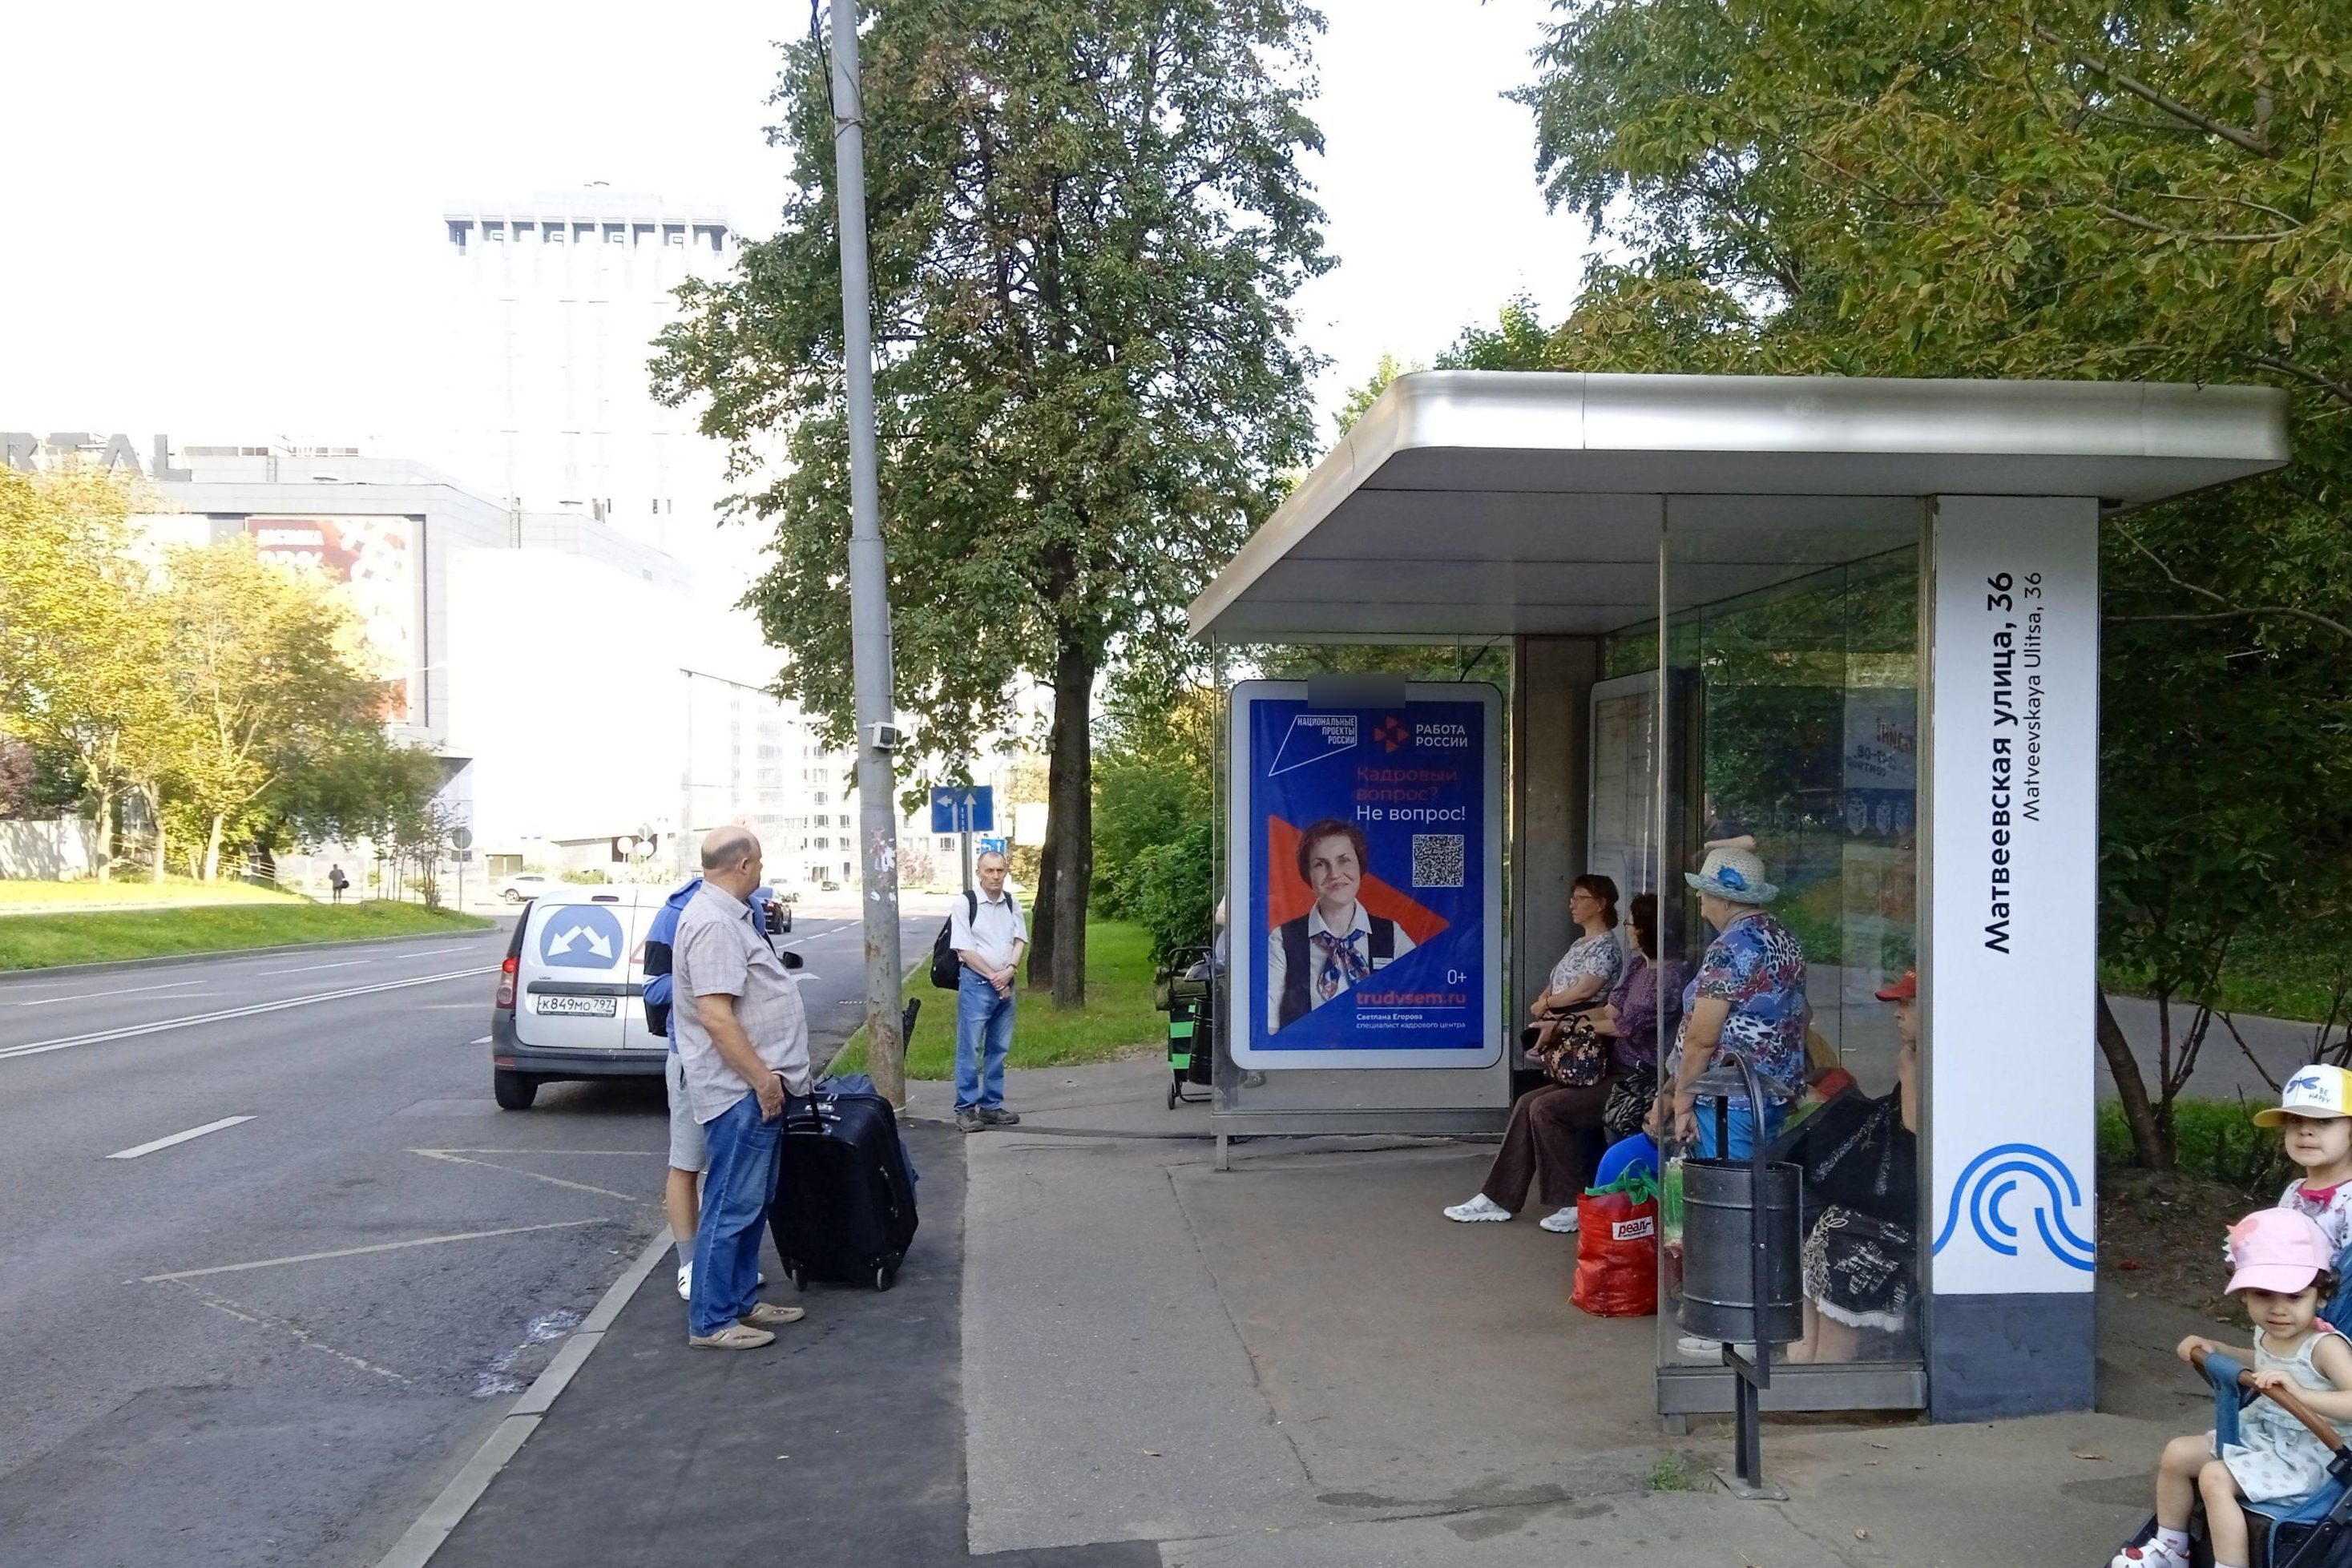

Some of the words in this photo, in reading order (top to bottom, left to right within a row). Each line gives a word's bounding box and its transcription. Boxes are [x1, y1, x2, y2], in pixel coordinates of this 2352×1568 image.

[1987, 572, 2014, 613] 36
[2024, 572, 2042, 599] 36
[2023, 607, 2044, 667] Ulitsa,
[1993, 623, 2019, 727] улица,
[1297, 717, 1355, 727] НАЦИОНАЛЬНЫЕ
[1415, 724, 1466, 735] РАБОТА
[1321, 727, 1355, 736] ПРОЕКТЫ
[1328, 736, 1355, 744] РОССИИ
[1415, 736, 1468, 748] РОССИИ
[2023, 675, 2045, 821] Matveevskaya
[1357, 766, 1458, 783] Кадровый
[1356, 787, 1438, 803] вопрос?
[1357, 805, 1383, 820] Не
[1389, 806, 1466, 824] вопрос!
[1984, 738, 2011, 954] Матвеевская
[1447, 969, 1467, 984] 0+
[542, 998, 591, 1011] К849МО
[593, 999, 611, 1009] 797
[1393, 1014, 1423, 1022] Егорова
[2309, 1094, 2330, 1103] HAPPY
[2319, 1087, 2328, 1096] BE
